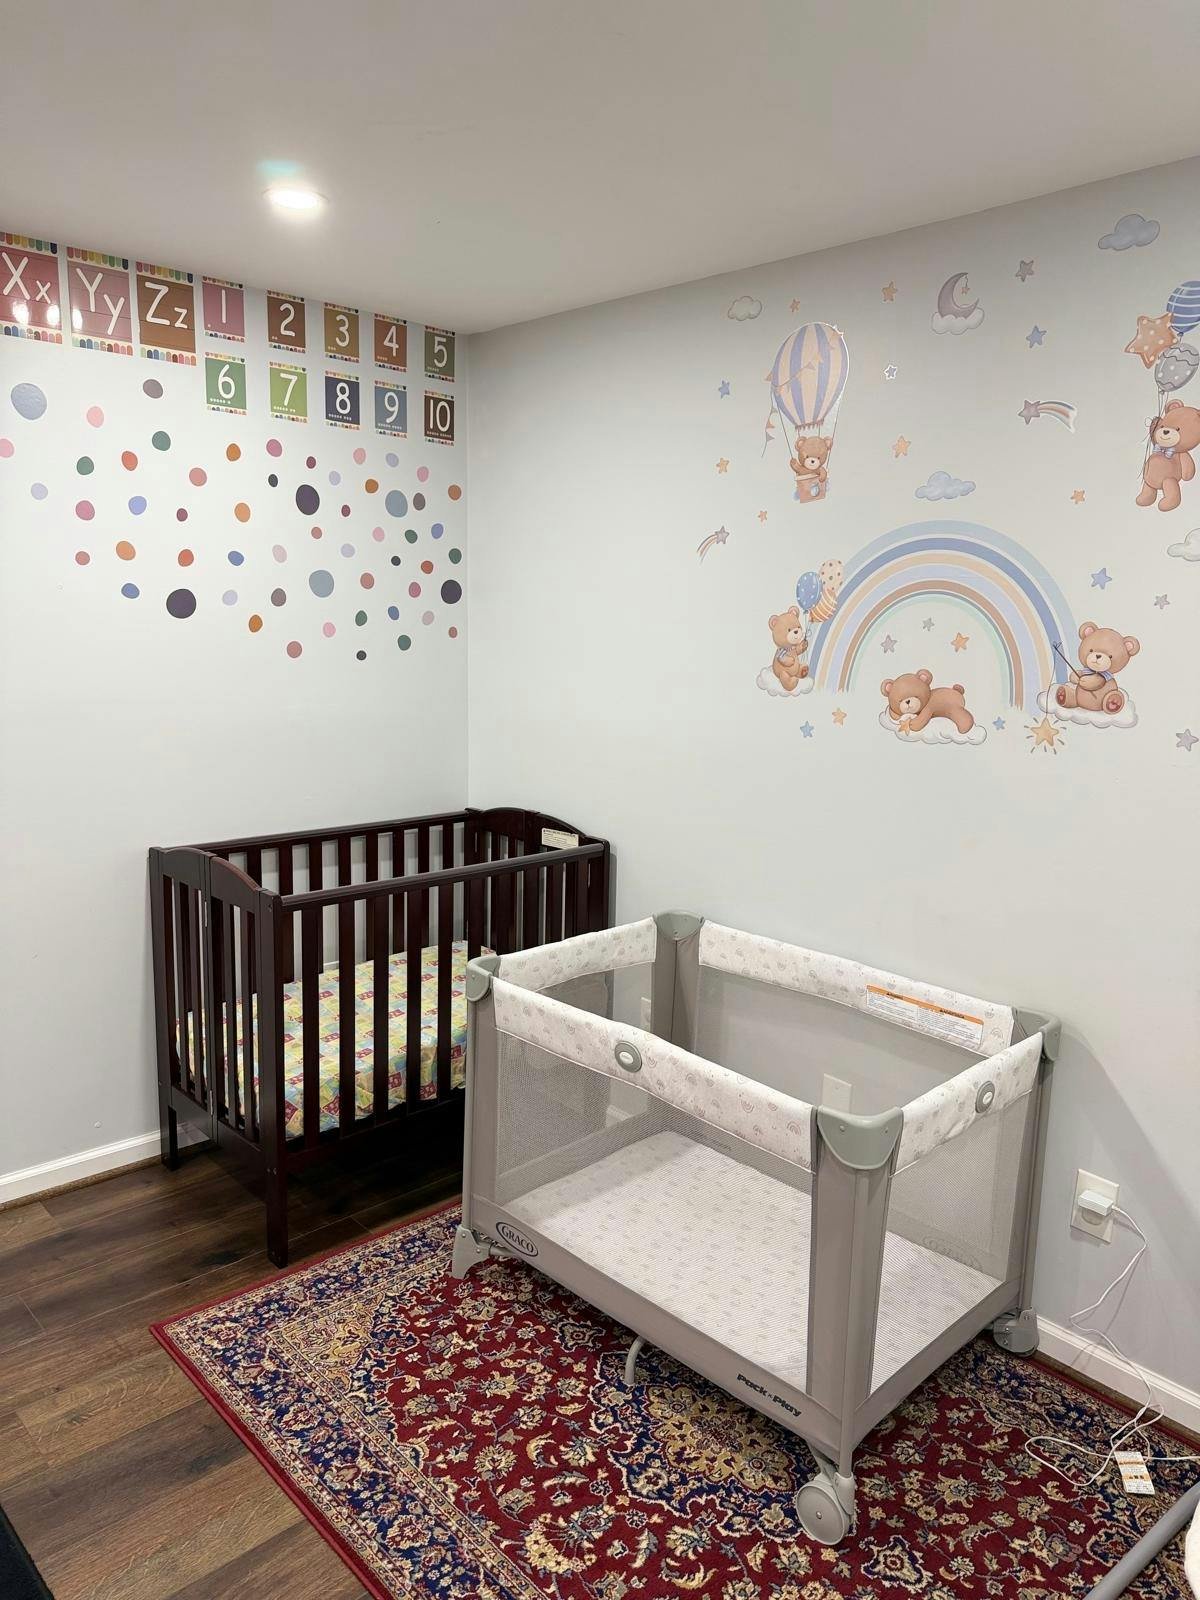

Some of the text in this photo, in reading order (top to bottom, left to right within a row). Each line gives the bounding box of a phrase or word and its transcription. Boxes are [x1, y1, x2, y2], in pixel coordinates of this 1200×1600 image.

[221, 289, 227, 324] 1
[279, 303, 295, 336] 2
[336, 314, 349, 347] 3
[384, 325, 399, 357] 4
[433, 336, 447, 368] 5
[218, 364, 236, 399] 6
[280, 373, 298, 406] 7
[336, 382, 351, 415] 8
[384, 391, 399, 424] 9
[429, 399, 451, 432] 10
[501, 1225, 534, 1253] GRACO
[737, 1373, 767, 1396] Pack
[773, 1395, 802, 1417] Play
